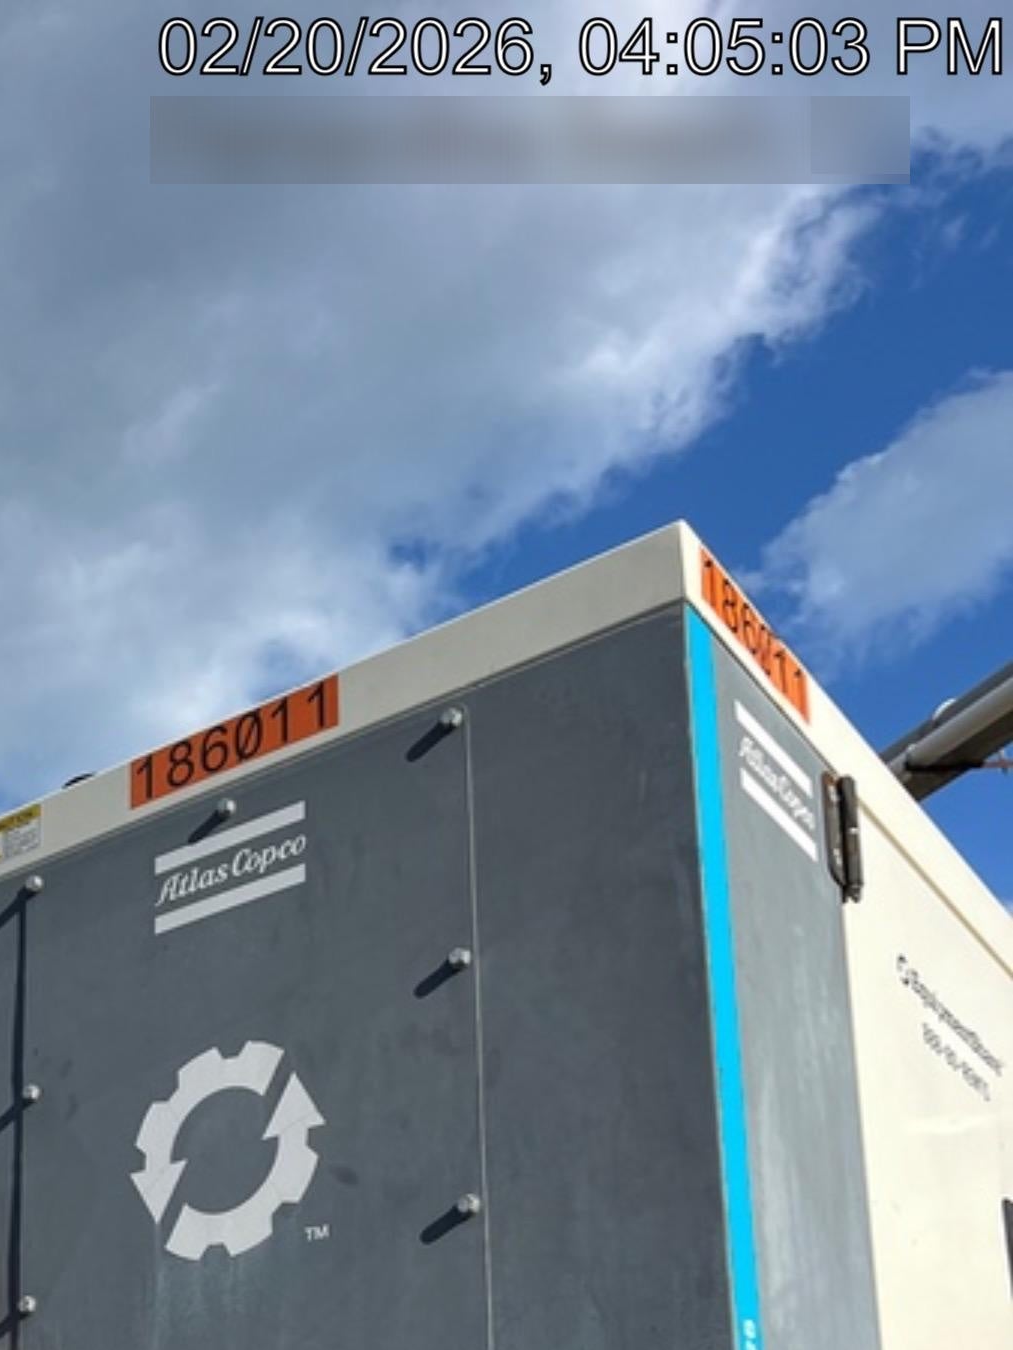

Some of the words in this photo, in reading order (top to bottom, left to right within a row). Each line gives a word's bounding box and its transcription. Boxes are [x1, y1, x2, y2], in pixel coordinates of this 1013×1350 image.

[705, 559, 807, 720] 186011
[136, 680, 326, 799] 186011
[154, 863, 229, 906] Atlas
[231, 835, 307, 877] Copco
